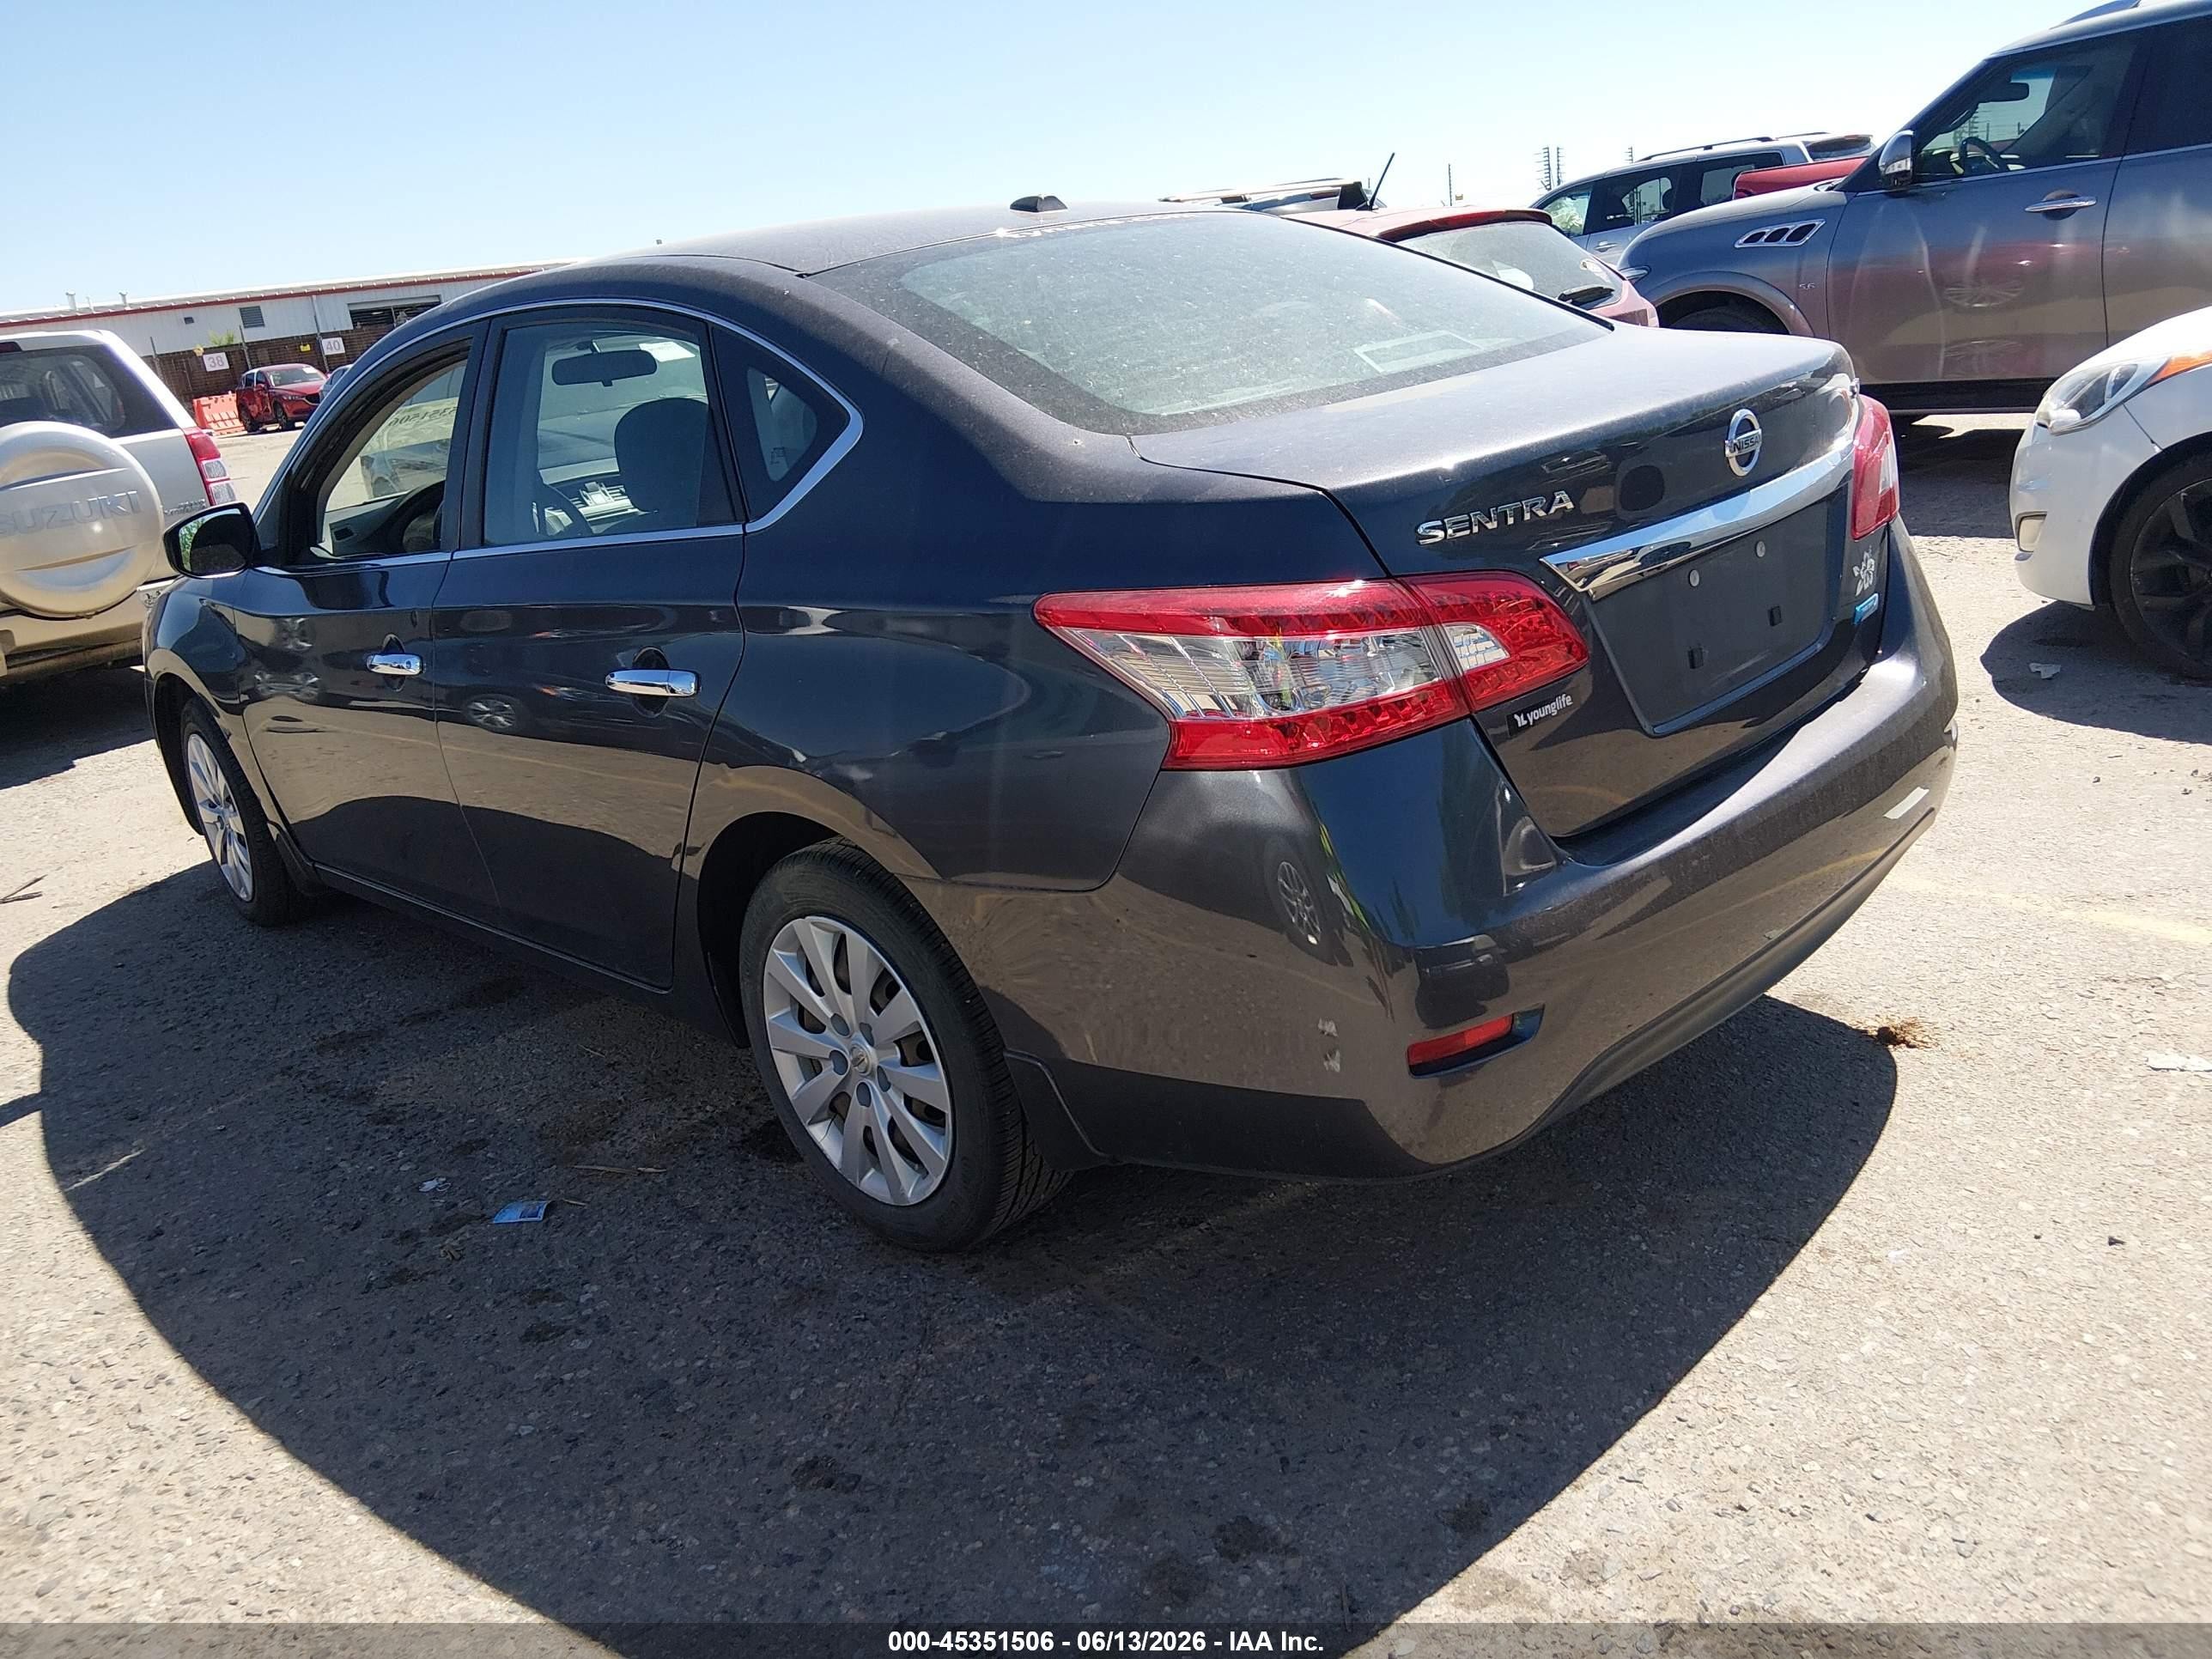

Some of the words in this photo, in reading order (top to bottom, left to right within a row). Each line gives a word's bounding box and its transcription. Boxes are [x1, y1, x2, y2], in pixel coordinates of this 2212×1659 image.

[325, 339, 341, 351] 40
[208, 356, 225, 368] 38
[1417, 489, 1574, 545] SENTRA
[1527, 694, 1574, 726] younglife
